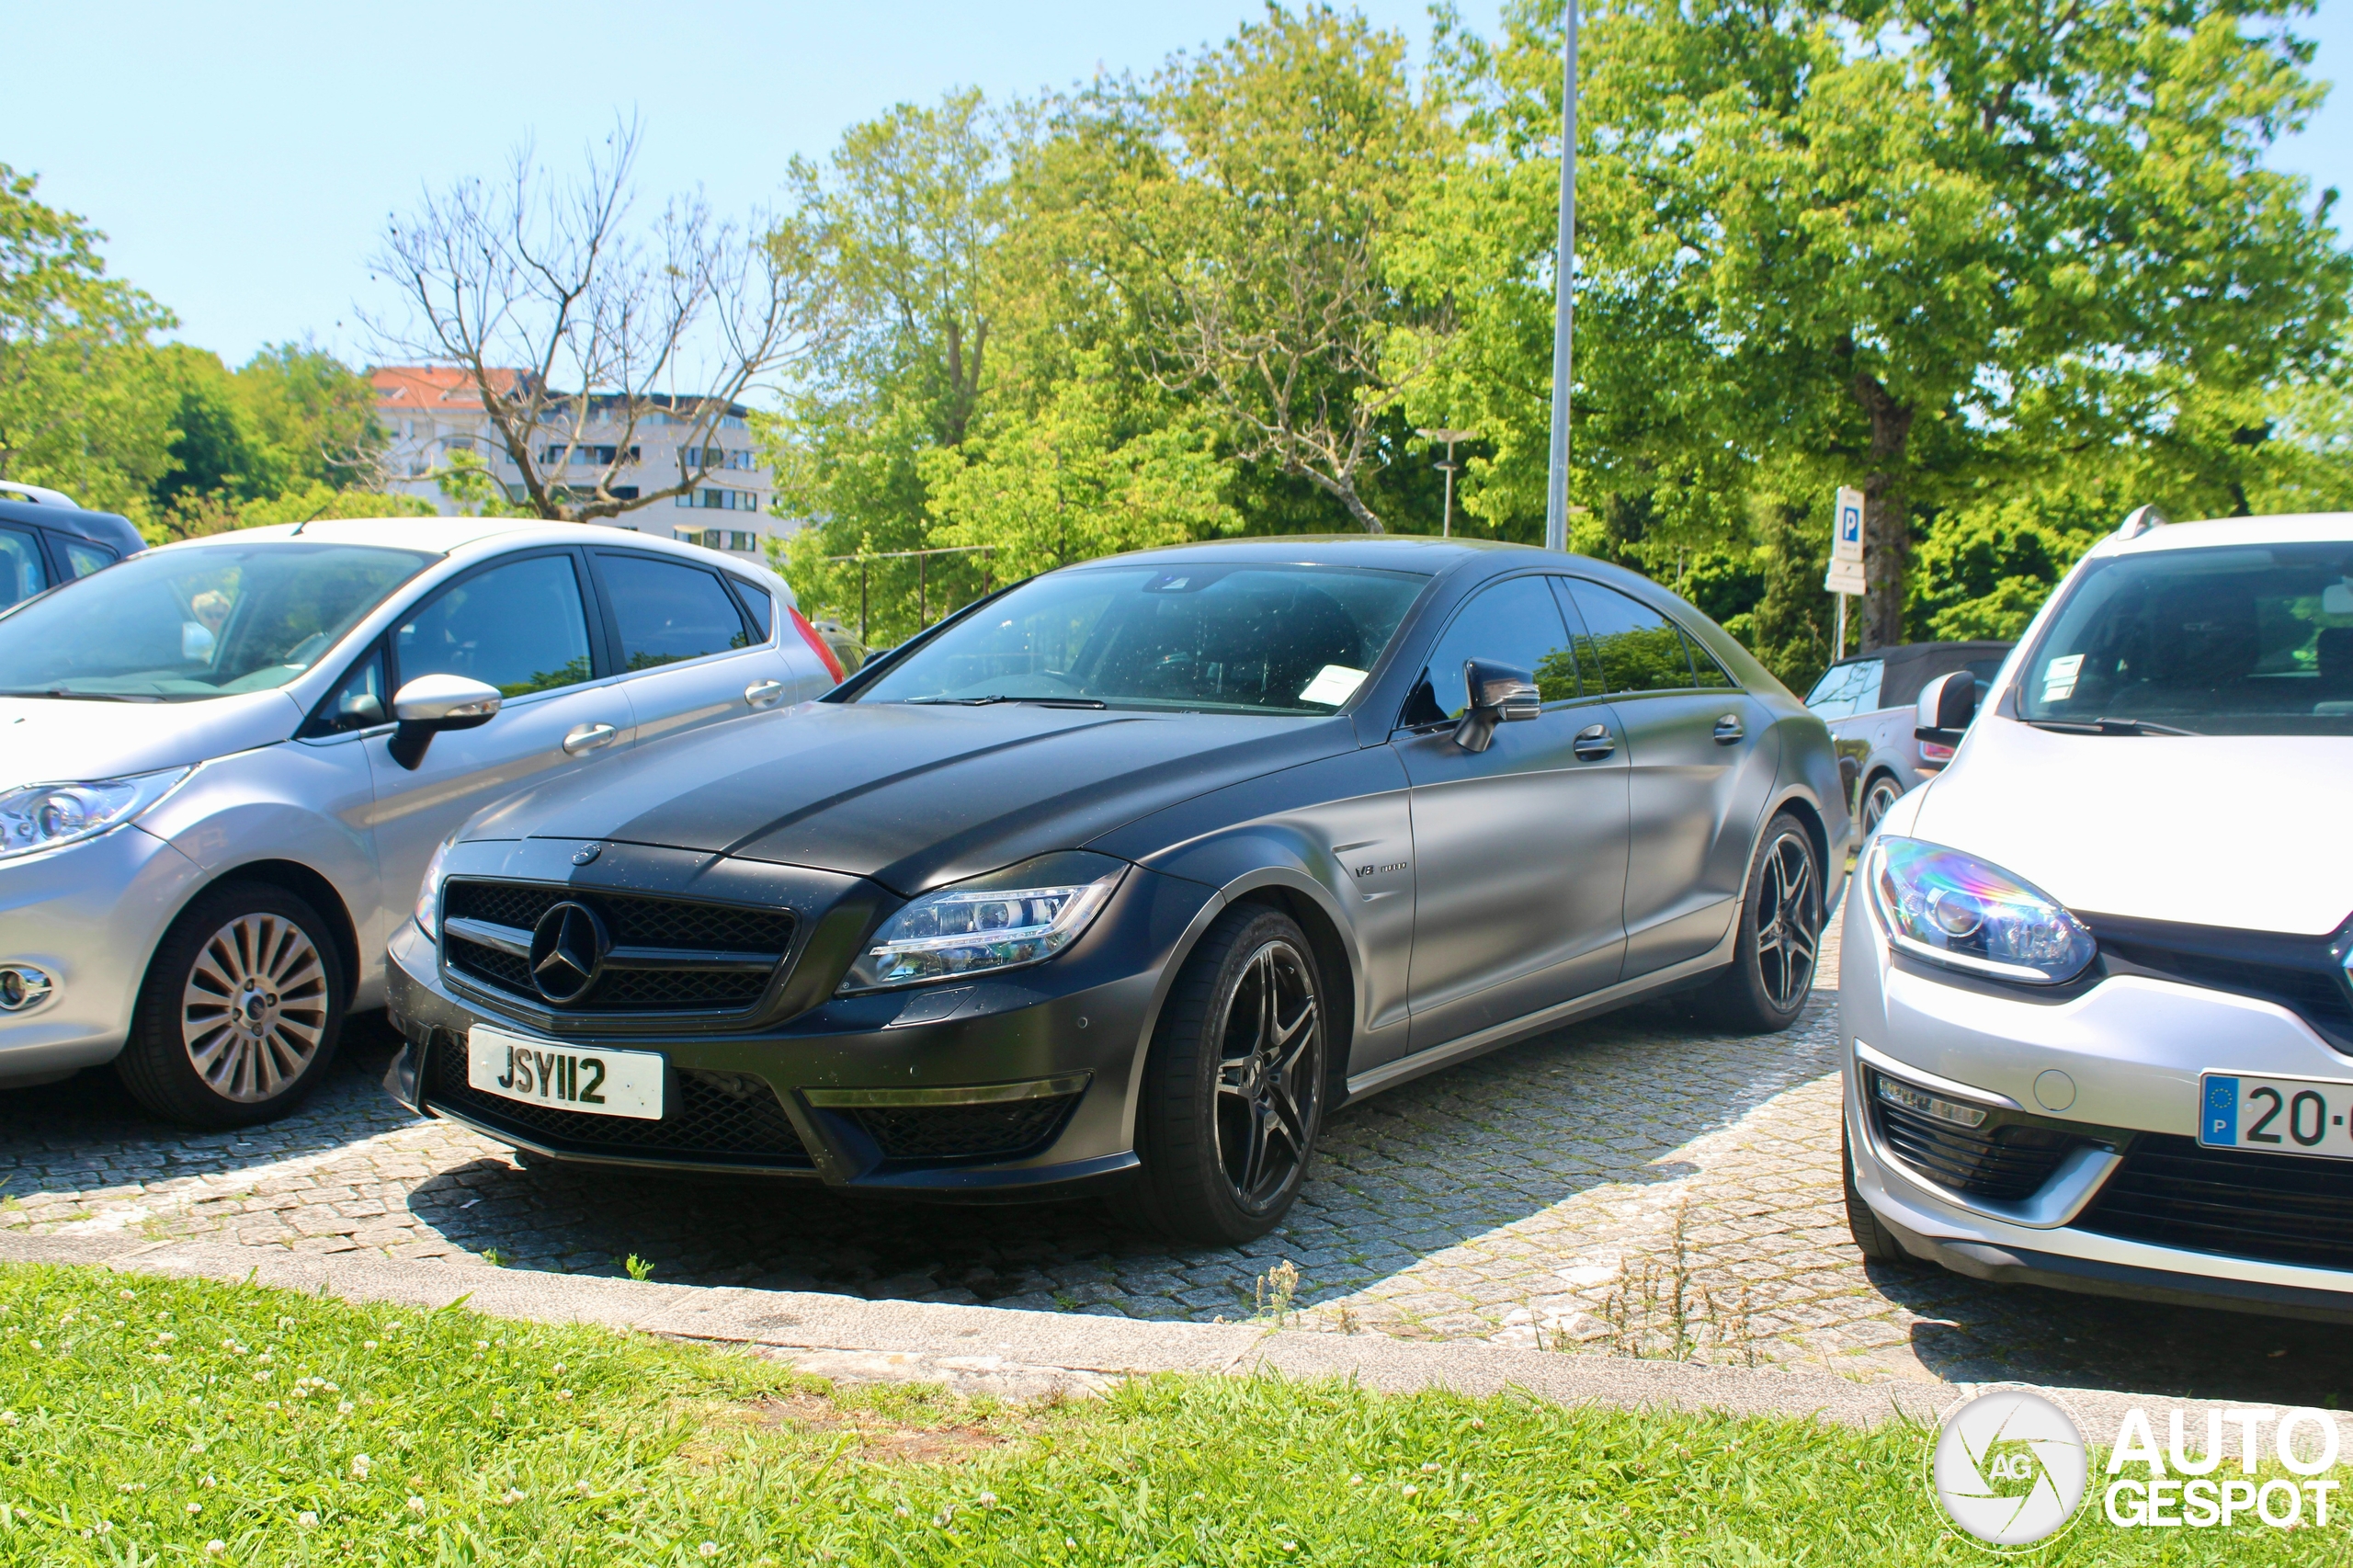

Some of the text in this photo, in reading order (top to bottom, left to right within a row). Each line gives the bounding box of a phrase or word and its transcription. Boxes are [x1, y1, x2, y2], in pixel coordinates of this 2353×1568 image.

[1844, 509, 1857, 540] P
[1355, 864, 1374, 878] V8
[497, 1045, 606, 1104] JSY112
[2213, 1119, 2227, 1133] P
